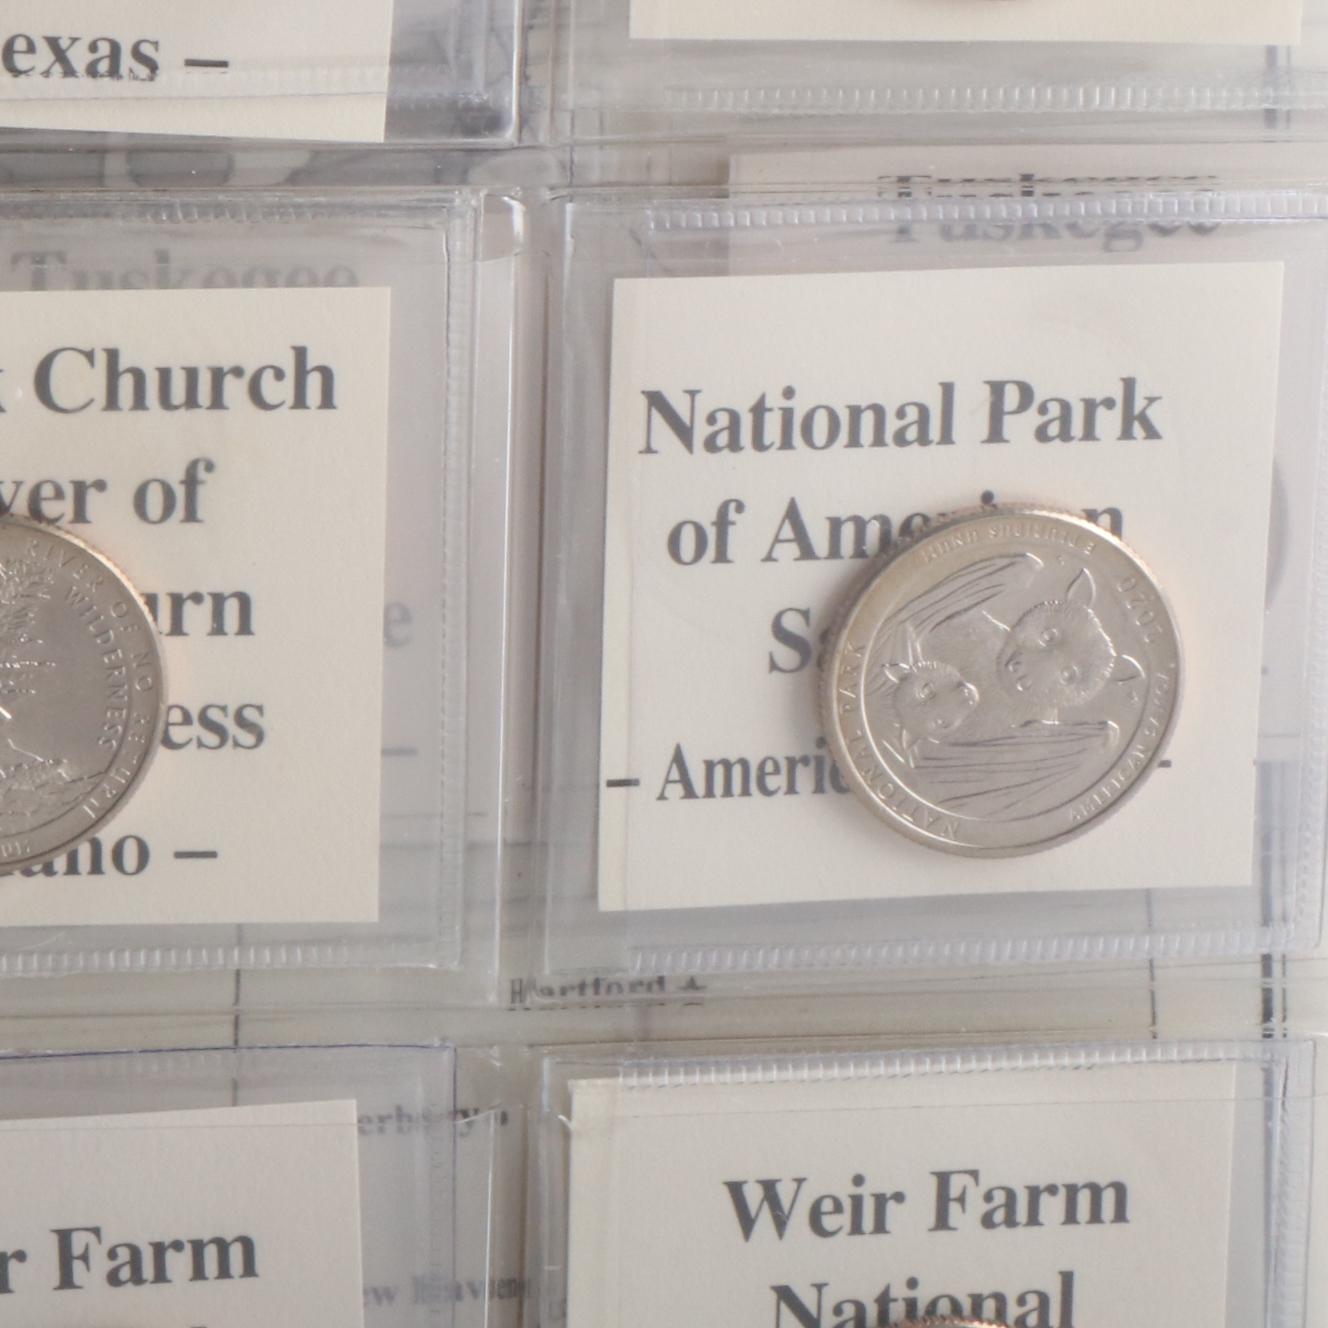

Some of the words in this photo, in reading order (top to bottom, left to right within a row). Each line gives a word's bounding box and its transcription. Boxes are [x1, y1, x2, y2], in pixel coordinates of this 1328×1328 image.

[33, 345, 339, 414] Church
[638, 380, 957, 455] National
[980, 376, 1163, 446] Park
[133, 457, 215, 525] of
[667, 499, 745, 565] of
[65, 586, 129, 750] WILDERNESS
[723, 1173, 906, 1243] Weir
[927, 1168, 1131, 1233] Farm
[50, 1226, 260, 1290] Farm
